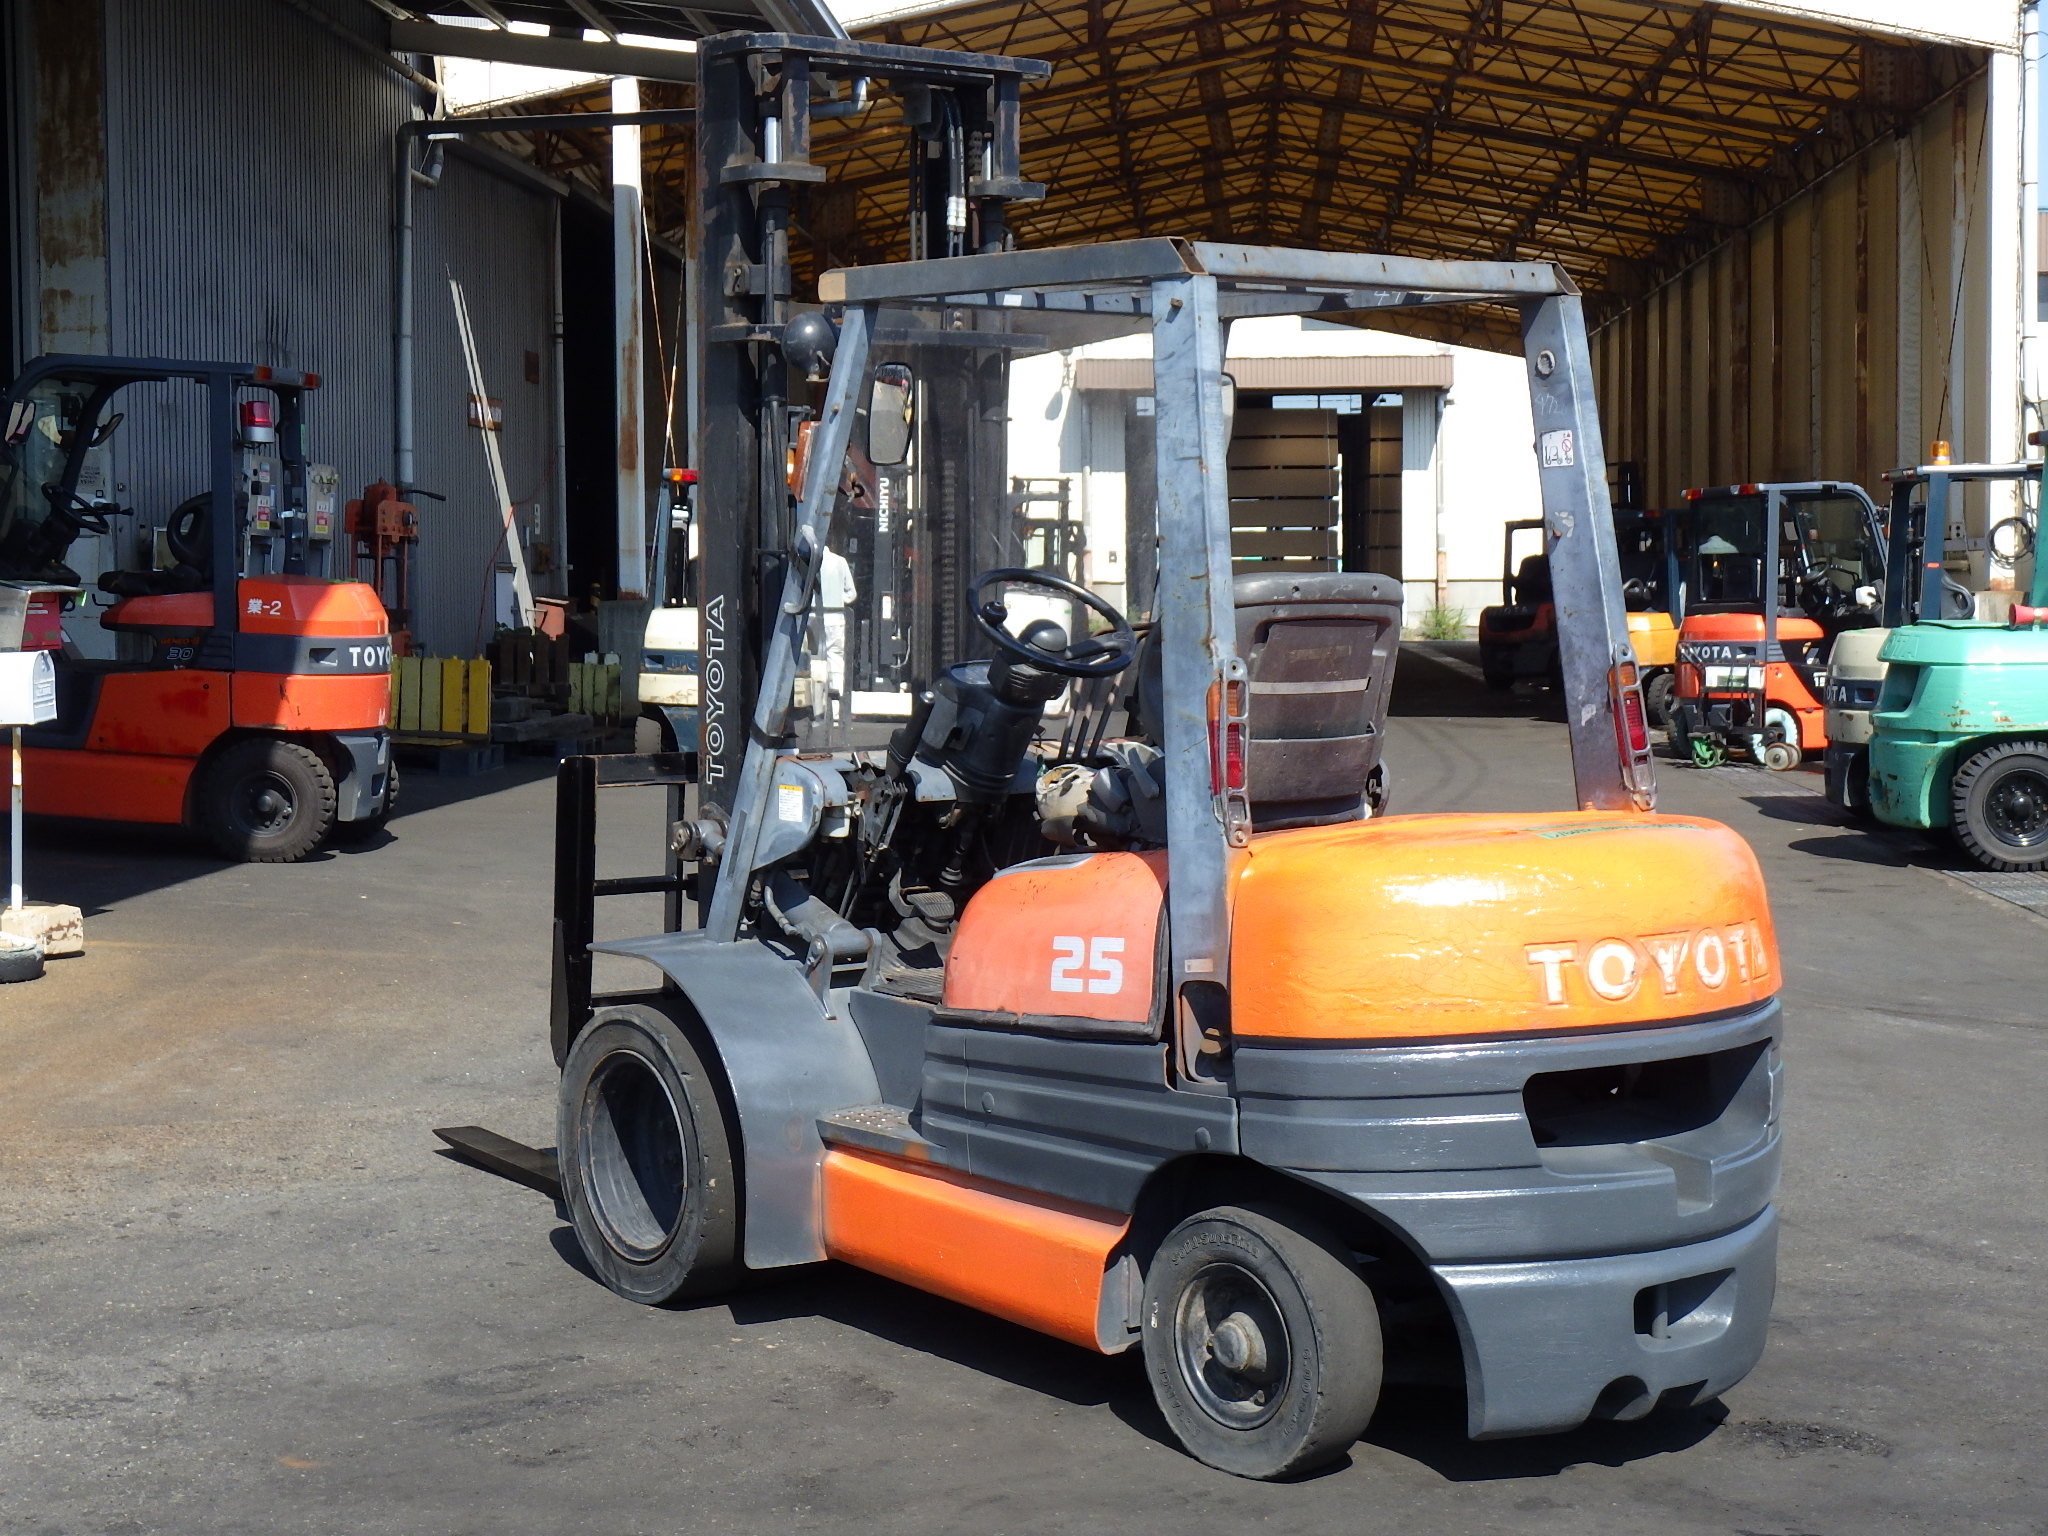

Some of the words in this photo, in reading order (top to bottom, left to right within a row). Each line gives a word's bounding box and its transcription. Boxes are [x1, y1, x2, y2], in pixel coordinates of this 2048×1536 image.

[879, 477, 889, 532] NICHIYU
[247, 598, 282, 616] 業-2
[167, 646, 194, 660] 30
[706, 594, 725, 785] TOYOTA
[1050, 935, 1125, 995] 25
[1524, 918, 1769, 1006] TOYOTA
